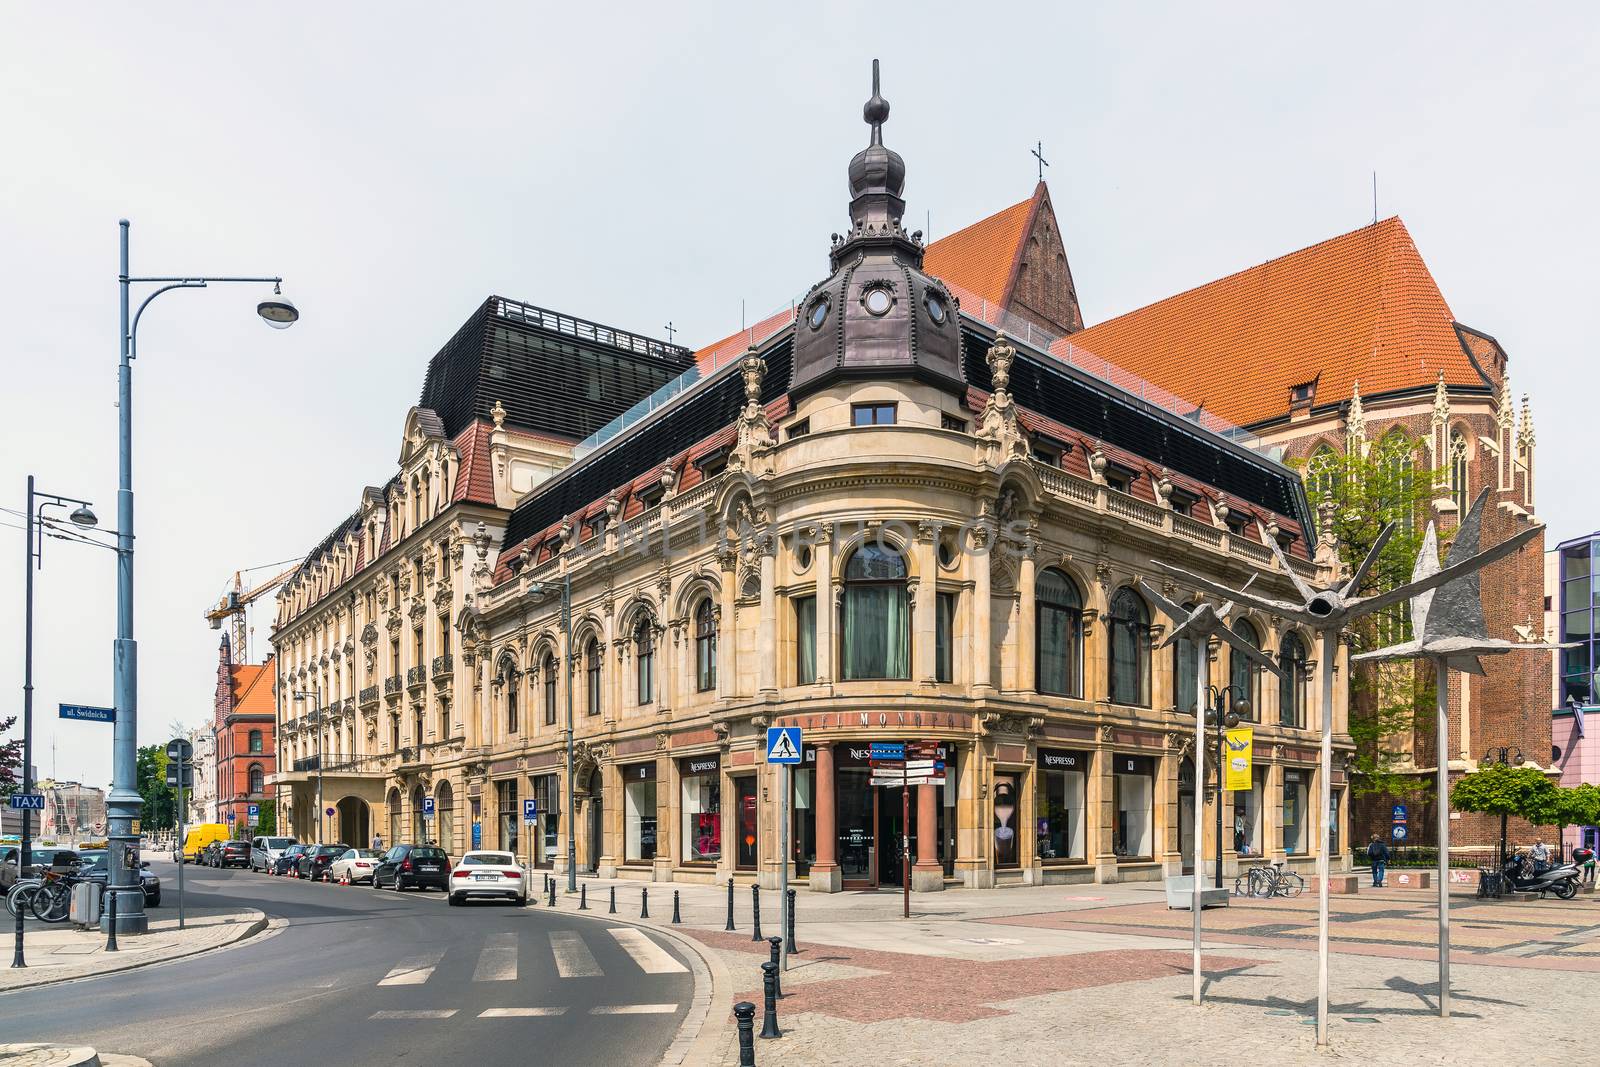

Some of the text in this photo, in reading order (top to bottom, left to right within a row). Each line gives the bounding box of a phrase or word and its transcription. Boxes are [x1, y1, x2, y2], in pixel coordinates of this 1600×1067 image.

[77, 709, 108, 719] Świdnicka
[859, 711, 967, 731] MONOPOL
[1045, 754, 1075, 766] NESPRESSO
[690, 761, 717, 772] NESPRESSO
[14, 796, 43, 808] TAXI
[526, 801, 535, 813] P
